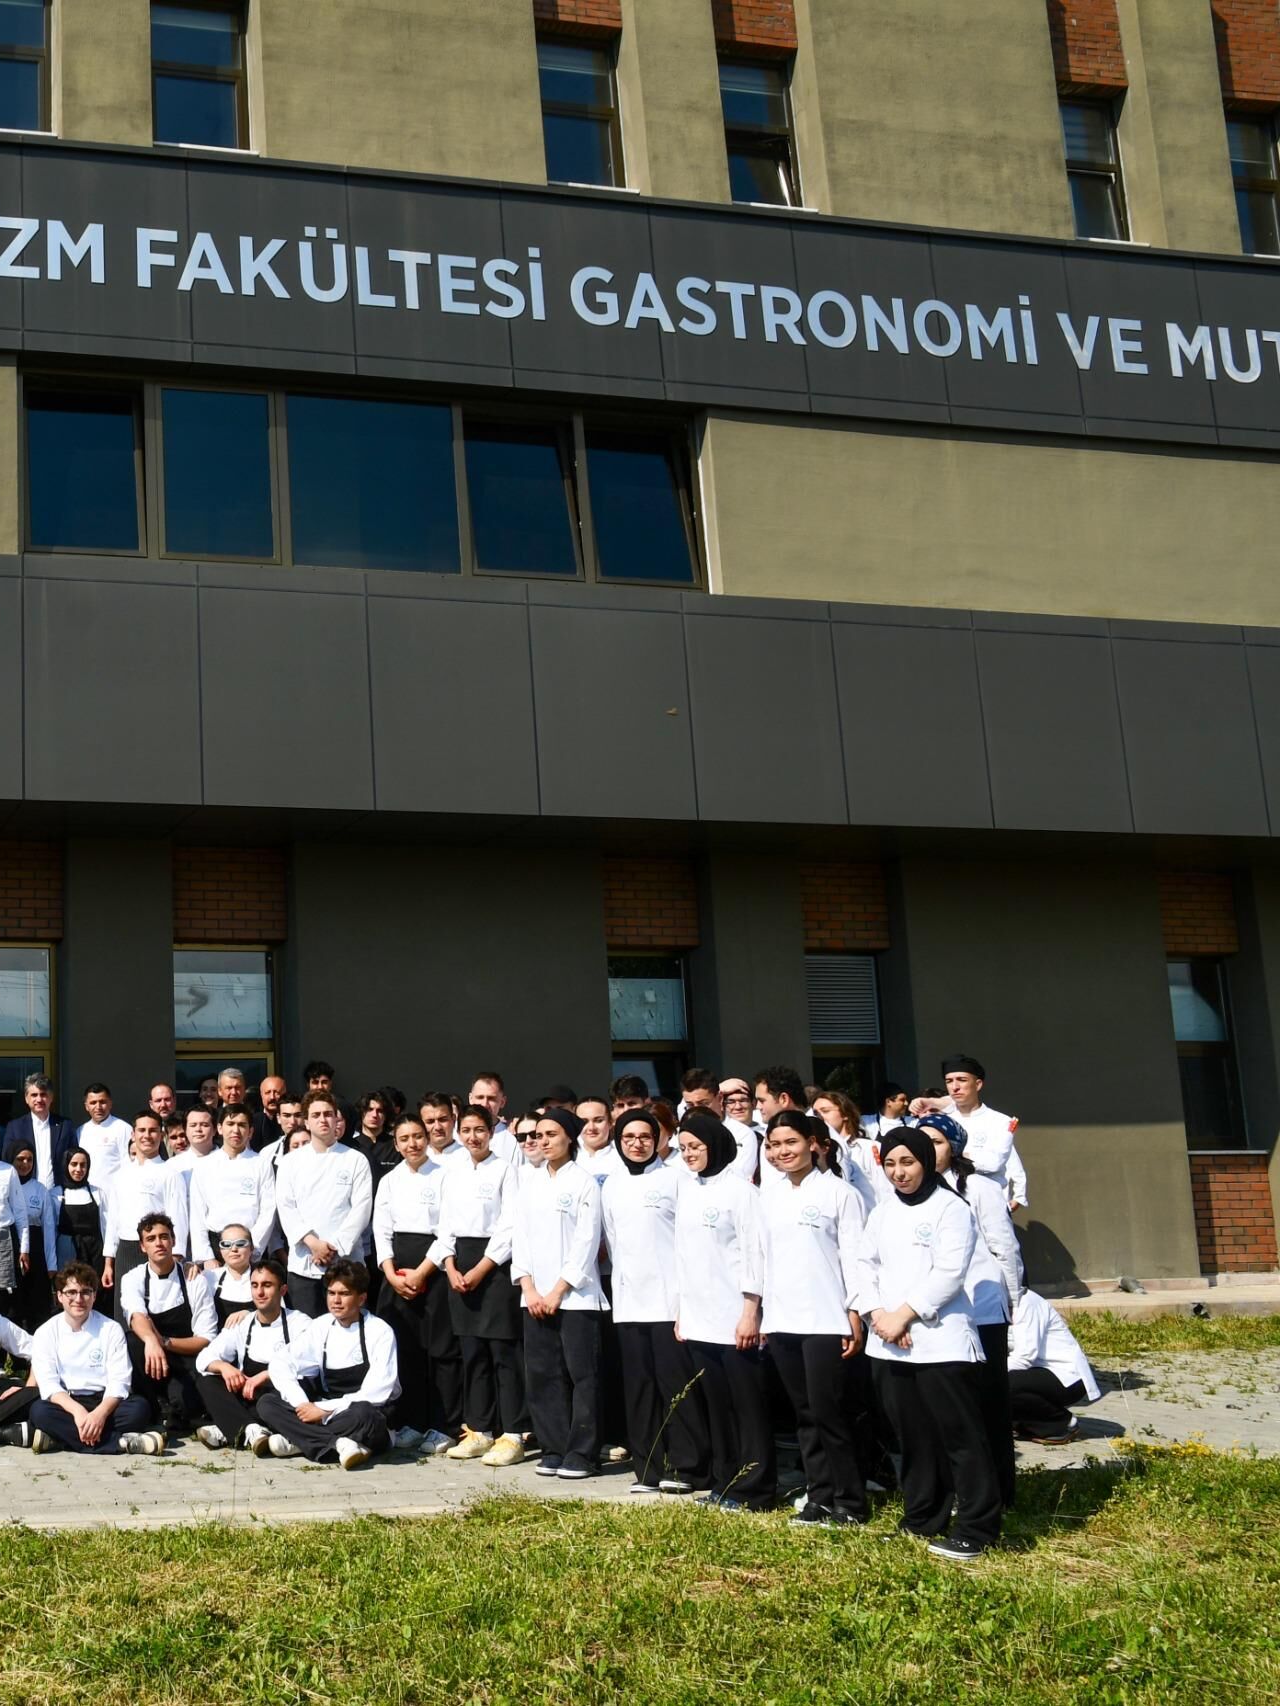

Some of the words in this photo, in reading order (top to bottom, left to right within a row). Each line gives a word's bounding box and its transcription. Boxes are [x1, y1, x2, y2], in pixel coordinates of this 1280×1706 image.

[136, 226, 546, 320] FAKÜLTESİ
[570, 267, 1038, 365] GASTRONOMİ
[1057, 314, 1149, 375] VE
